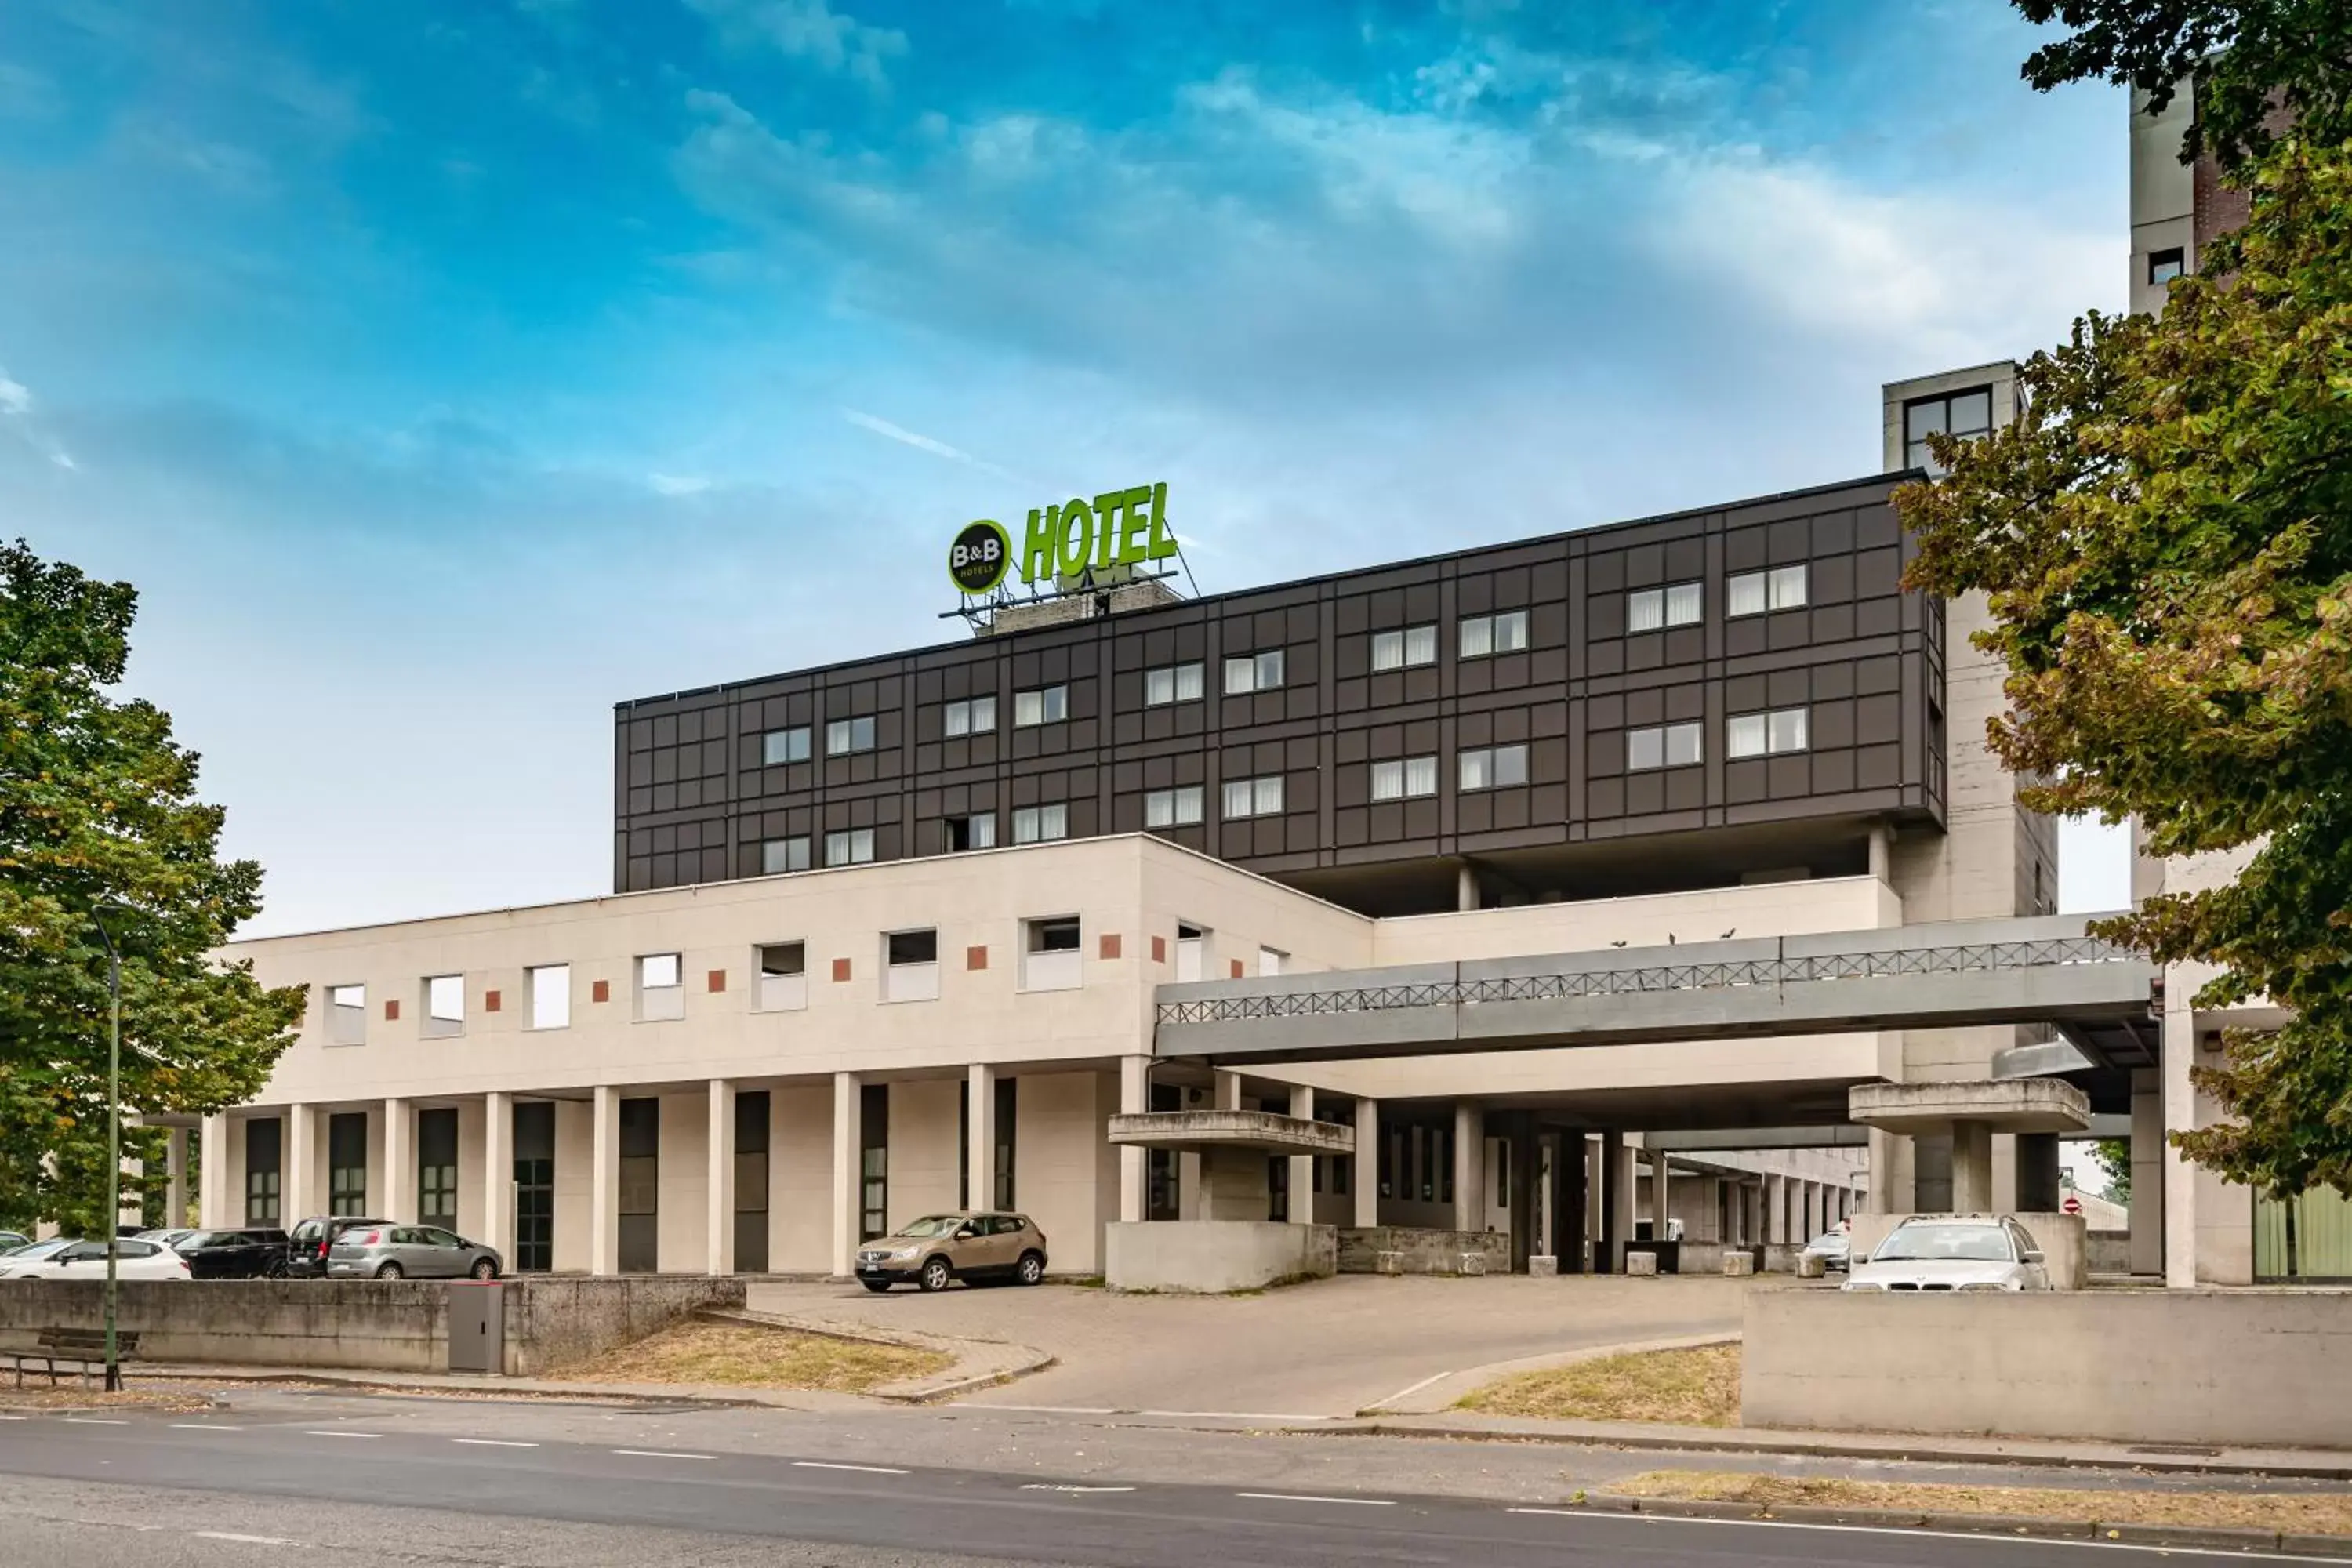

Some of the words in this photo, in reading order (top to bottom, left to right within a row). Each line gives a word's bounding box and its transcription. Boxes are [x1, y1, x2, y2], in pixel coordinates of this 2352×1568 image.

[1021, 482, 1178, 584] HOTEL
[953, 539, 1000, 568] B&B
[960, 564, 994, 578] HOTELS
